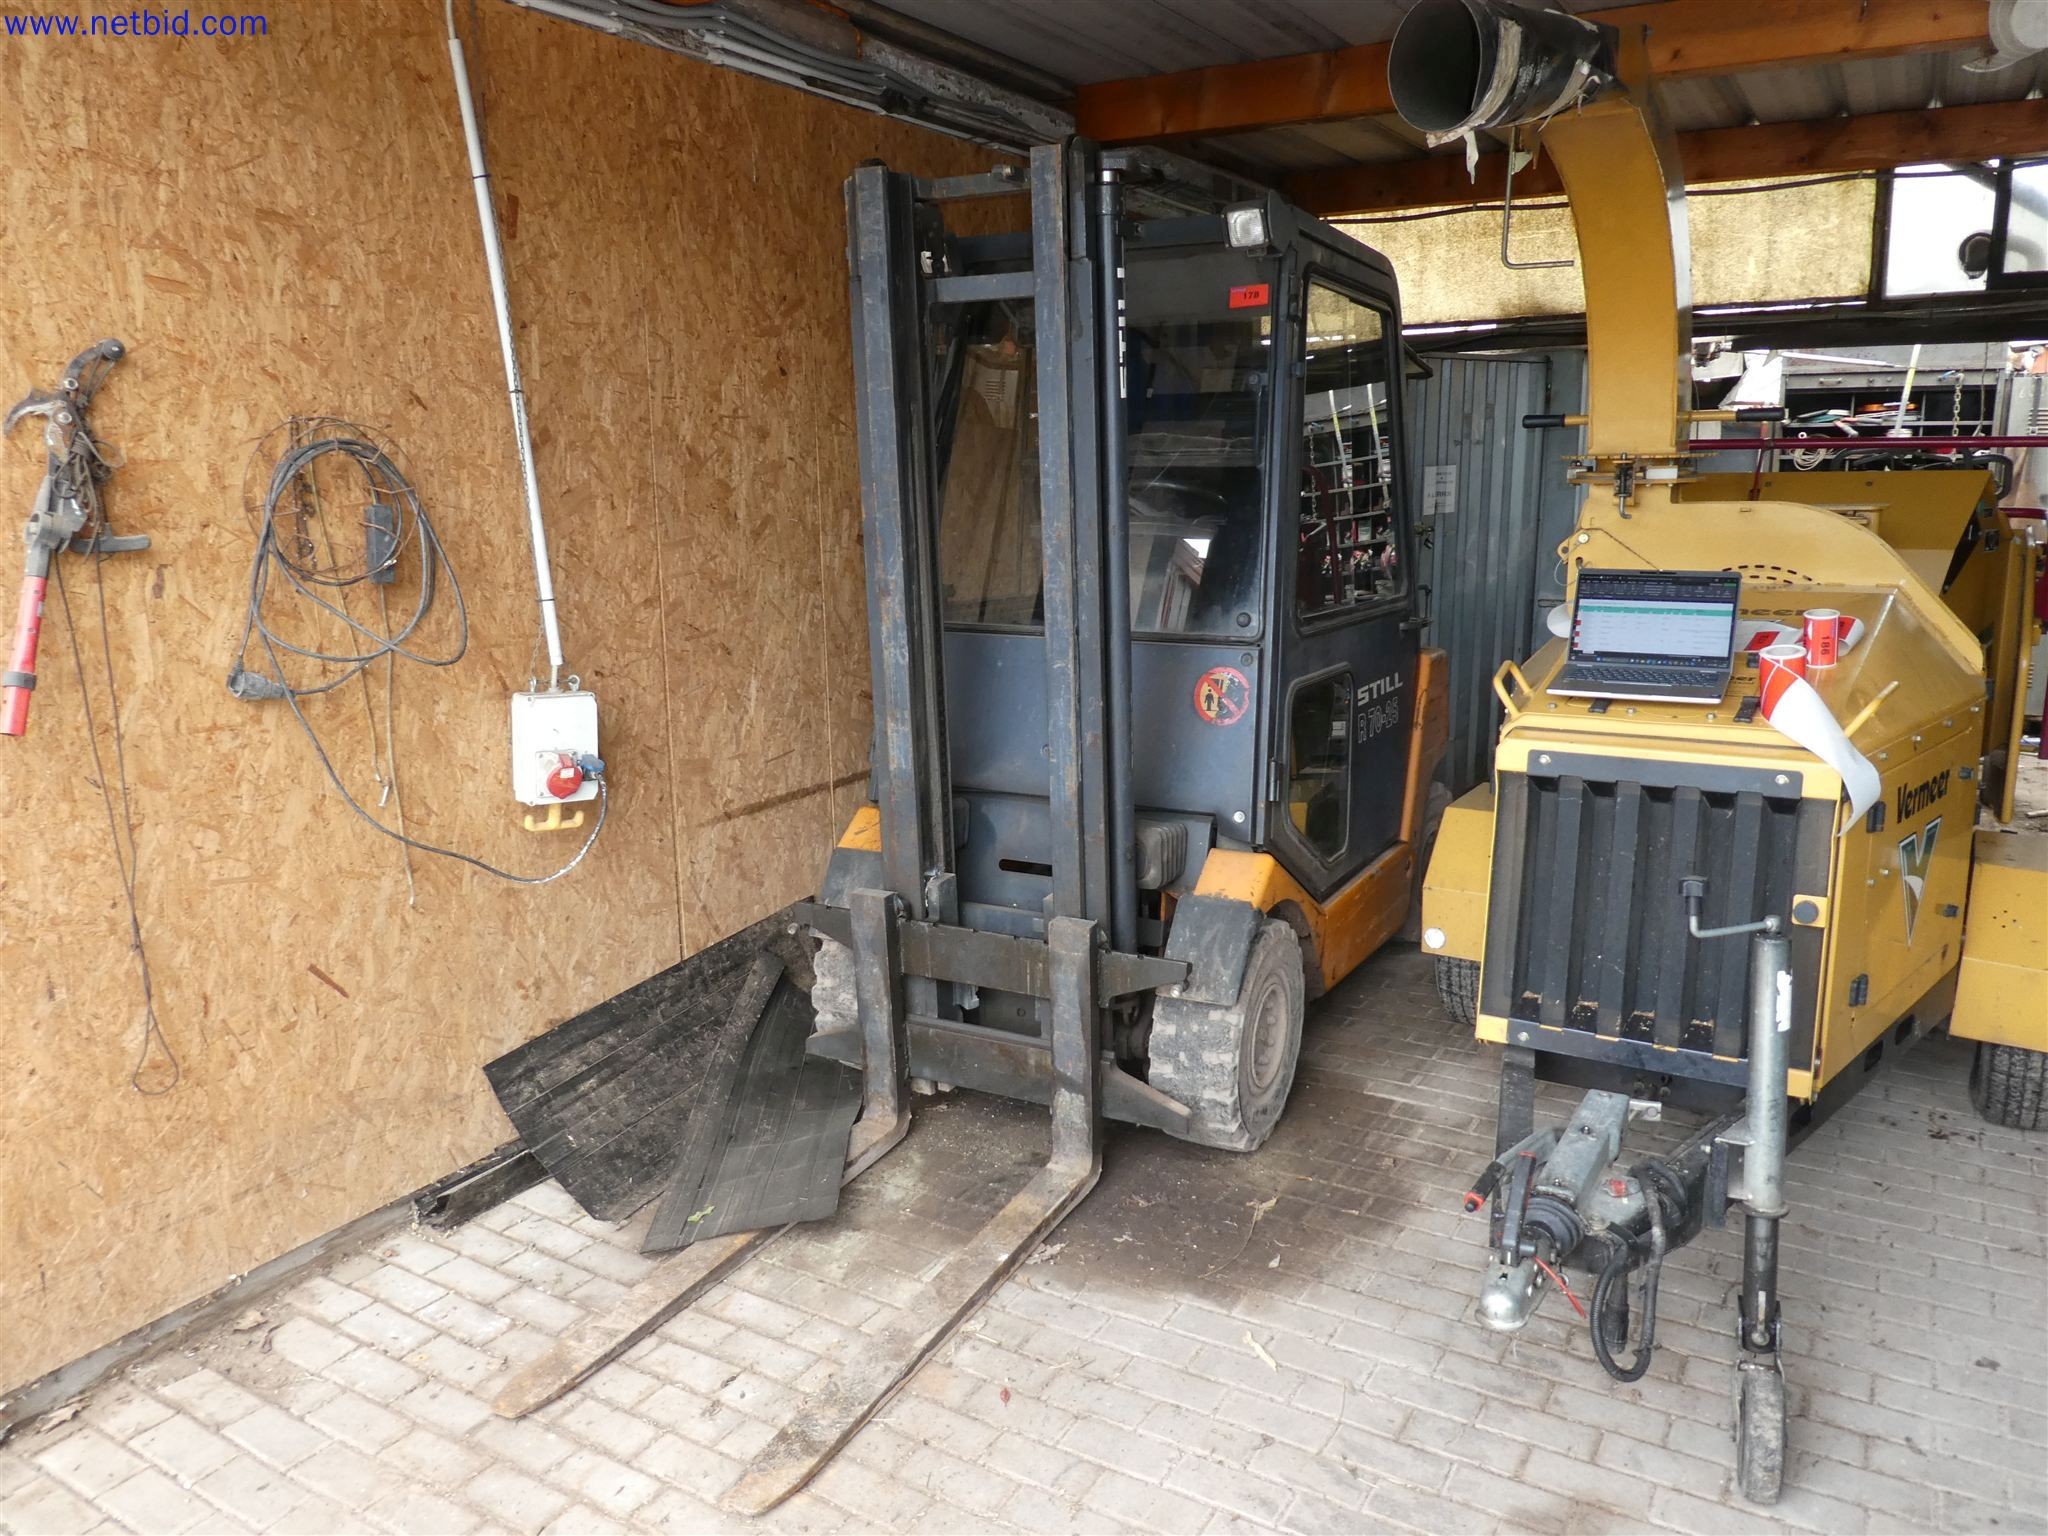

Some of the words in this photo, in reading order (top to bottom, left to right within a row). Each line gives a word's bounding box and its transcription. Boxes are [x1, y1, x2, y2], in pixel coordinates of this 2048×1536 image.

[1820, 636, 1831, 655] 186
[1357, 672, 1403, 707] STILL
[1357, 712, 1367, 744] R
[1897, 768, 1951, 824] Vermeer
